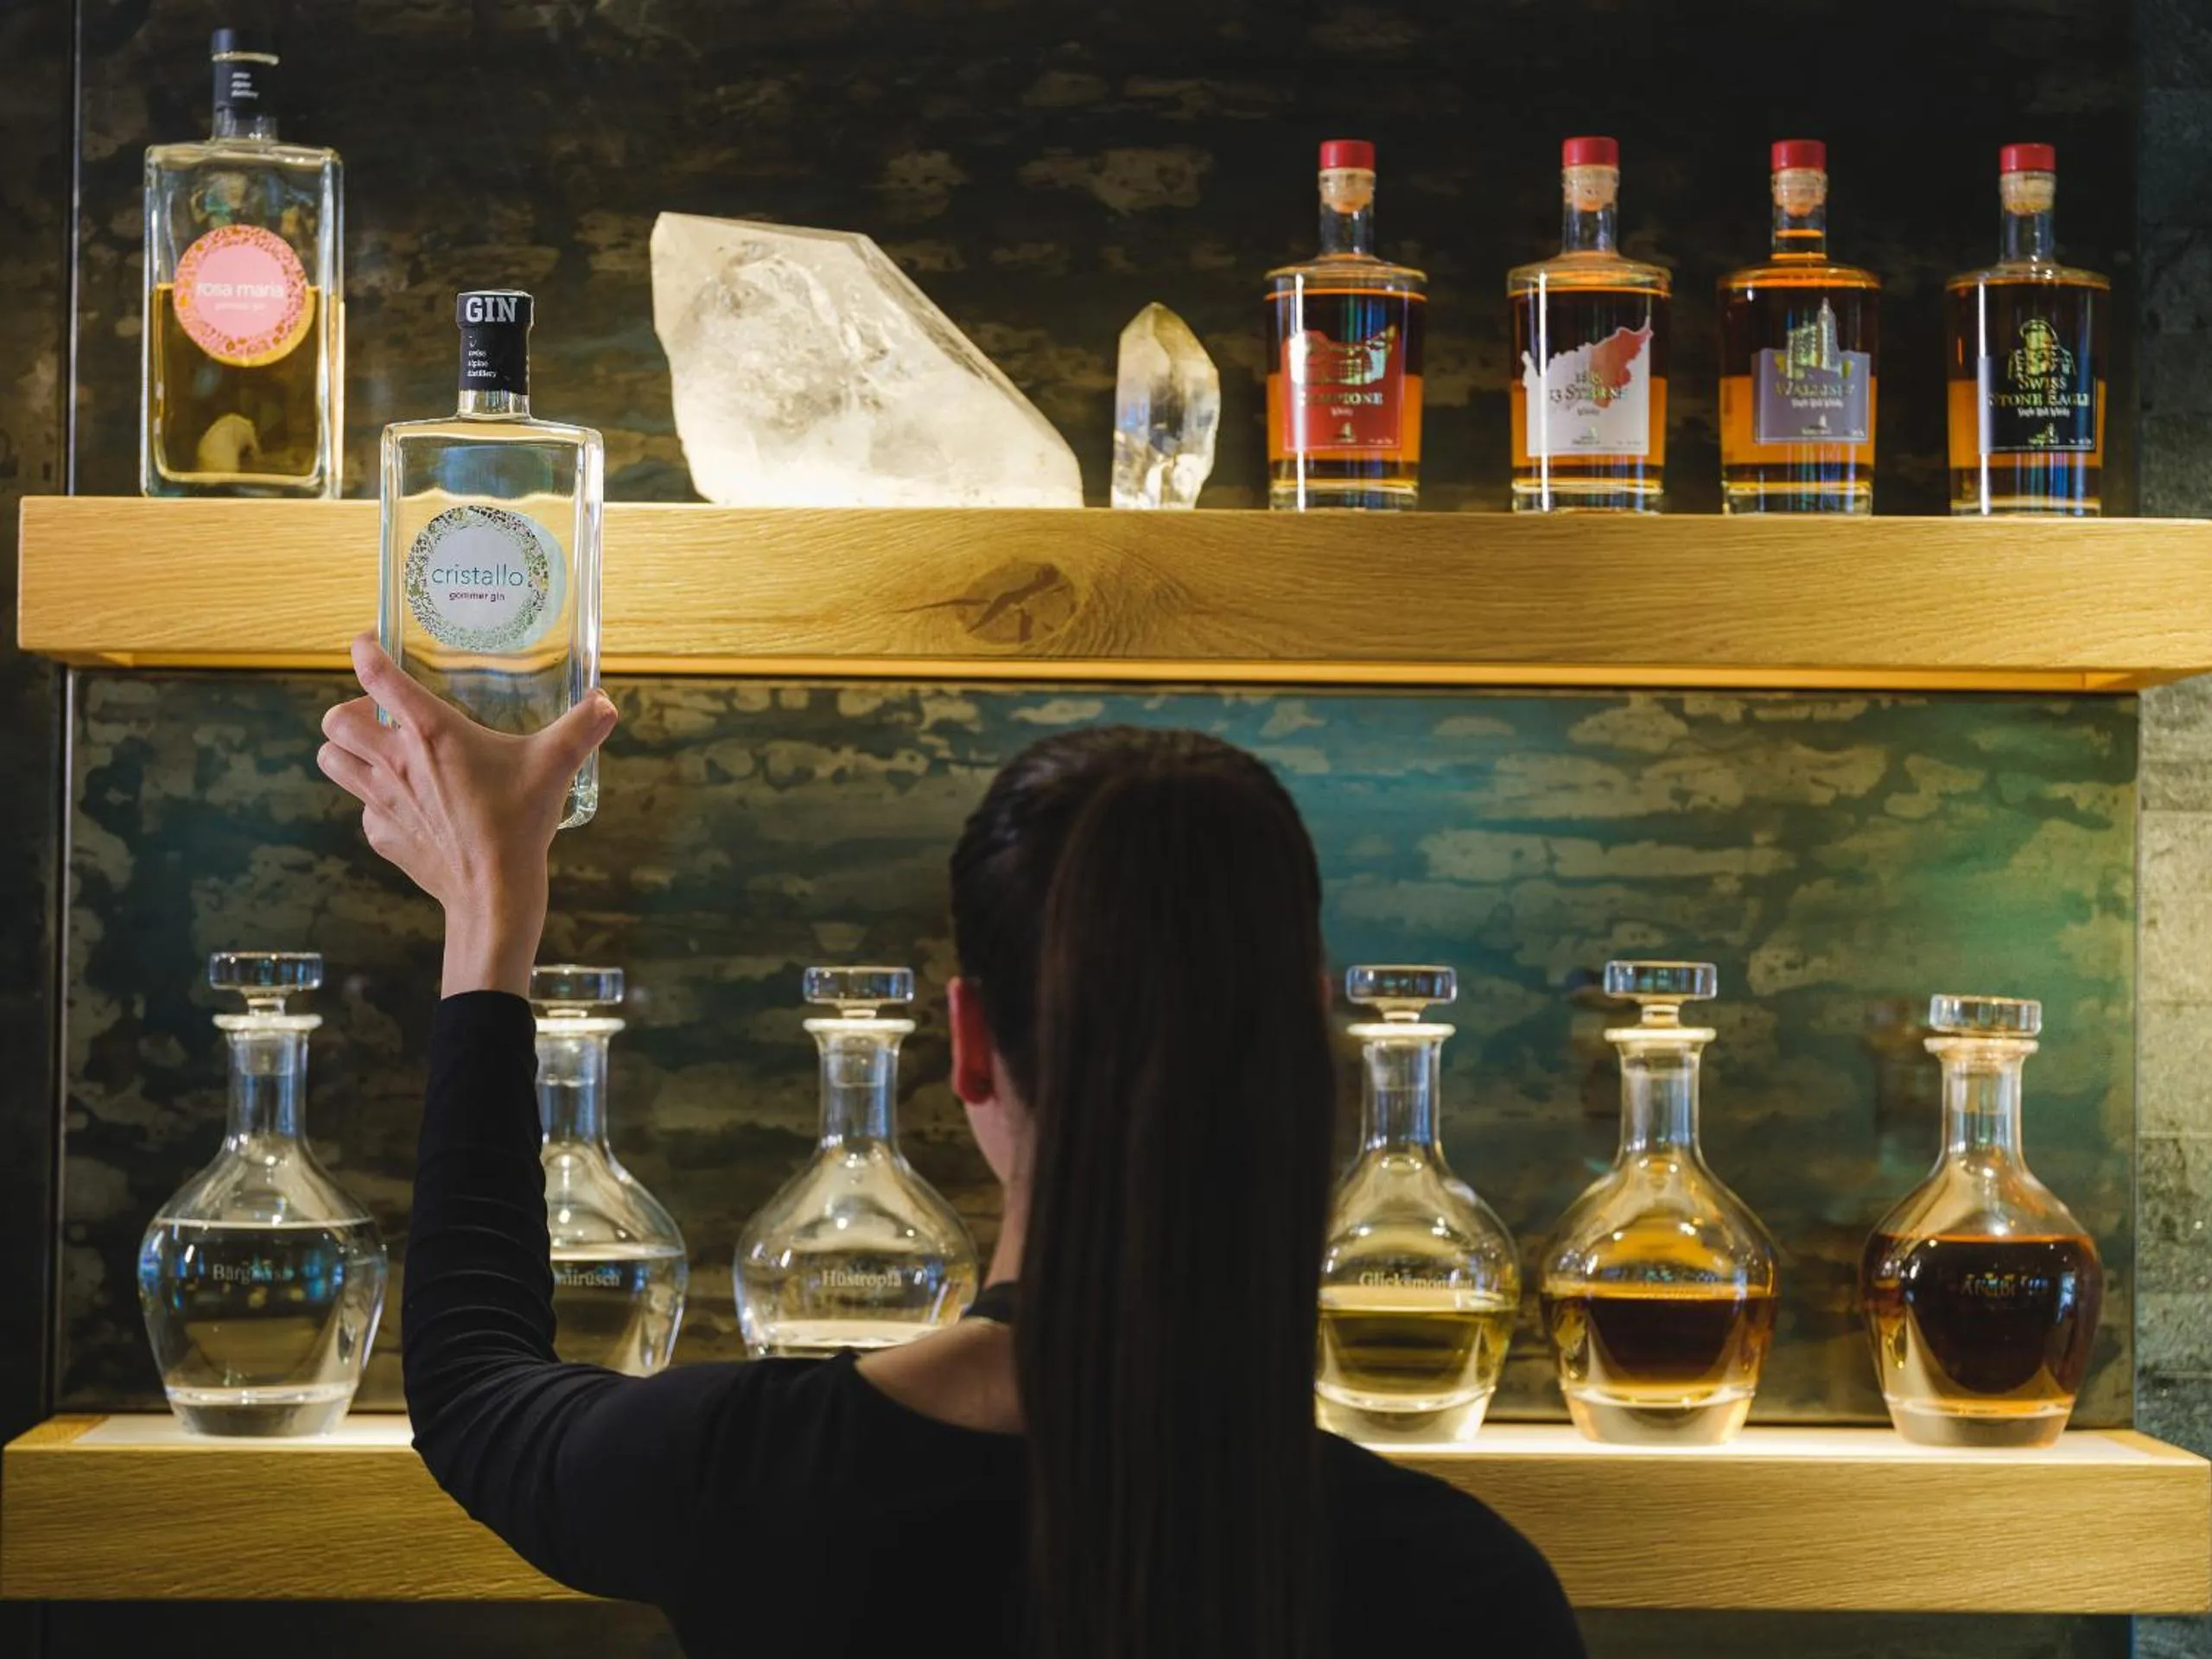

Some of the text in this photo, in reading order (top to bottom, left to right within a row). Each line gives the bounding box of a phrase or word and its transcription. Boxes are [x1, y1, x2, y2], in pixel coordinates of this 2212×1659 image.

[196, 283, 284, 298] rosa maria
[466, 296, 518, 322] GIN
[2018, 376, 2068, 391] SWISS
[431, 563, 524, 586] cristallo
[490, 591, 505, 602] gin
